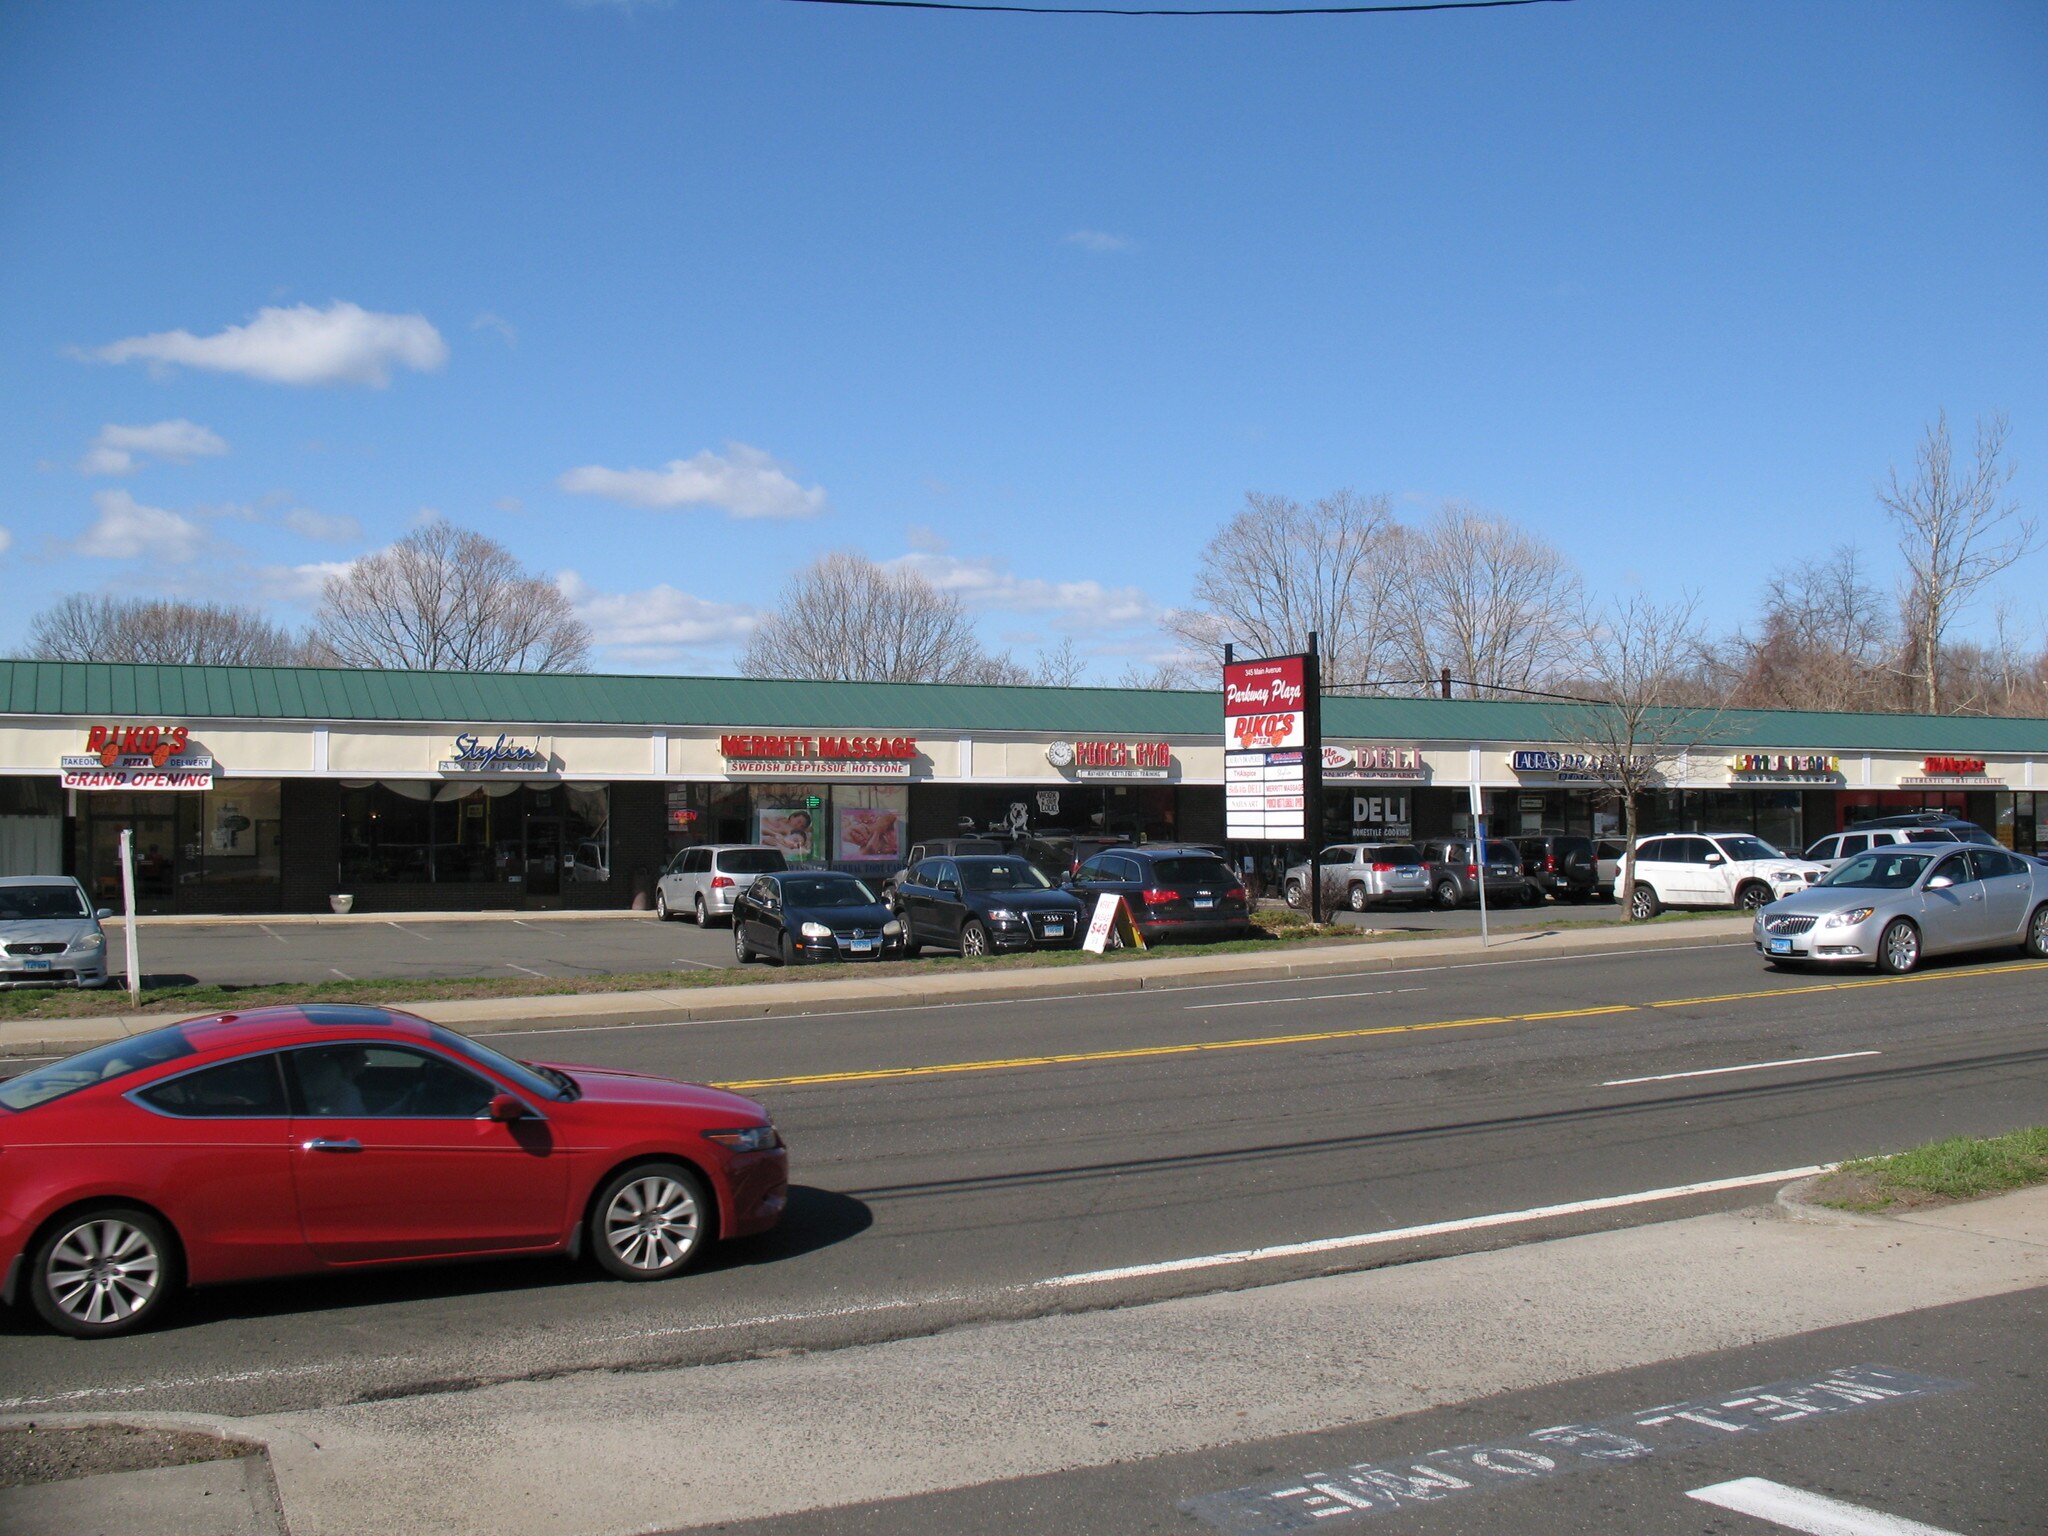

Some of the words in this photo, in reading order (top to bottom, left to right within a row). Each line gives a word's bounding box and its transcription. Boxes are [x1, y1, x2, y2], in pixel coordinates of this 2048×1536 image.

[1227, 683, 1269, 707] Parkway
[1272, 679, 1301, 706] Plaza
[1234, 714, 1295, 738] RIKO'S
[86, 726, 189, 754] RIKO'S
[720, 735, 812, 757] MERRITT
[818, 737, 917, 758] MASSAGE
[1075, 741, 1127, 767] PUNCH
[1136, 743, 1171, 768] GYM
[1328, 755, 1345, 766] Vita
[1353, 746, 1421, 769] DELI
[63, 758, 100, 766] TAKEOUT
[122, 758, 149, 767] PIZZA
[170, 759, 208, 767] DELIVERY
[1735, 754, 1786, 771] LITTLE
[1789, 755, 1840, 771] PEOPLE
[852, 765, 904, 774] HOTSTONE
[1335, 771, 1370, 779] KITCHEN
[65, 771, 127, 786] GRAND
[131, 772, 211, 787] OPENING
[1248, 784, 1261, 793] DELI
[674, 811, 697, 820] OPEN
[1353, 797, 1406, 822] DELI
[1352, 829, 1382, 837] HOMESTYLE
[1384, 829, 1410, 837] COOKING
[1090, 922, 1108, 935] $49
[1273, 1366, 1912, 1517] WELCOME
